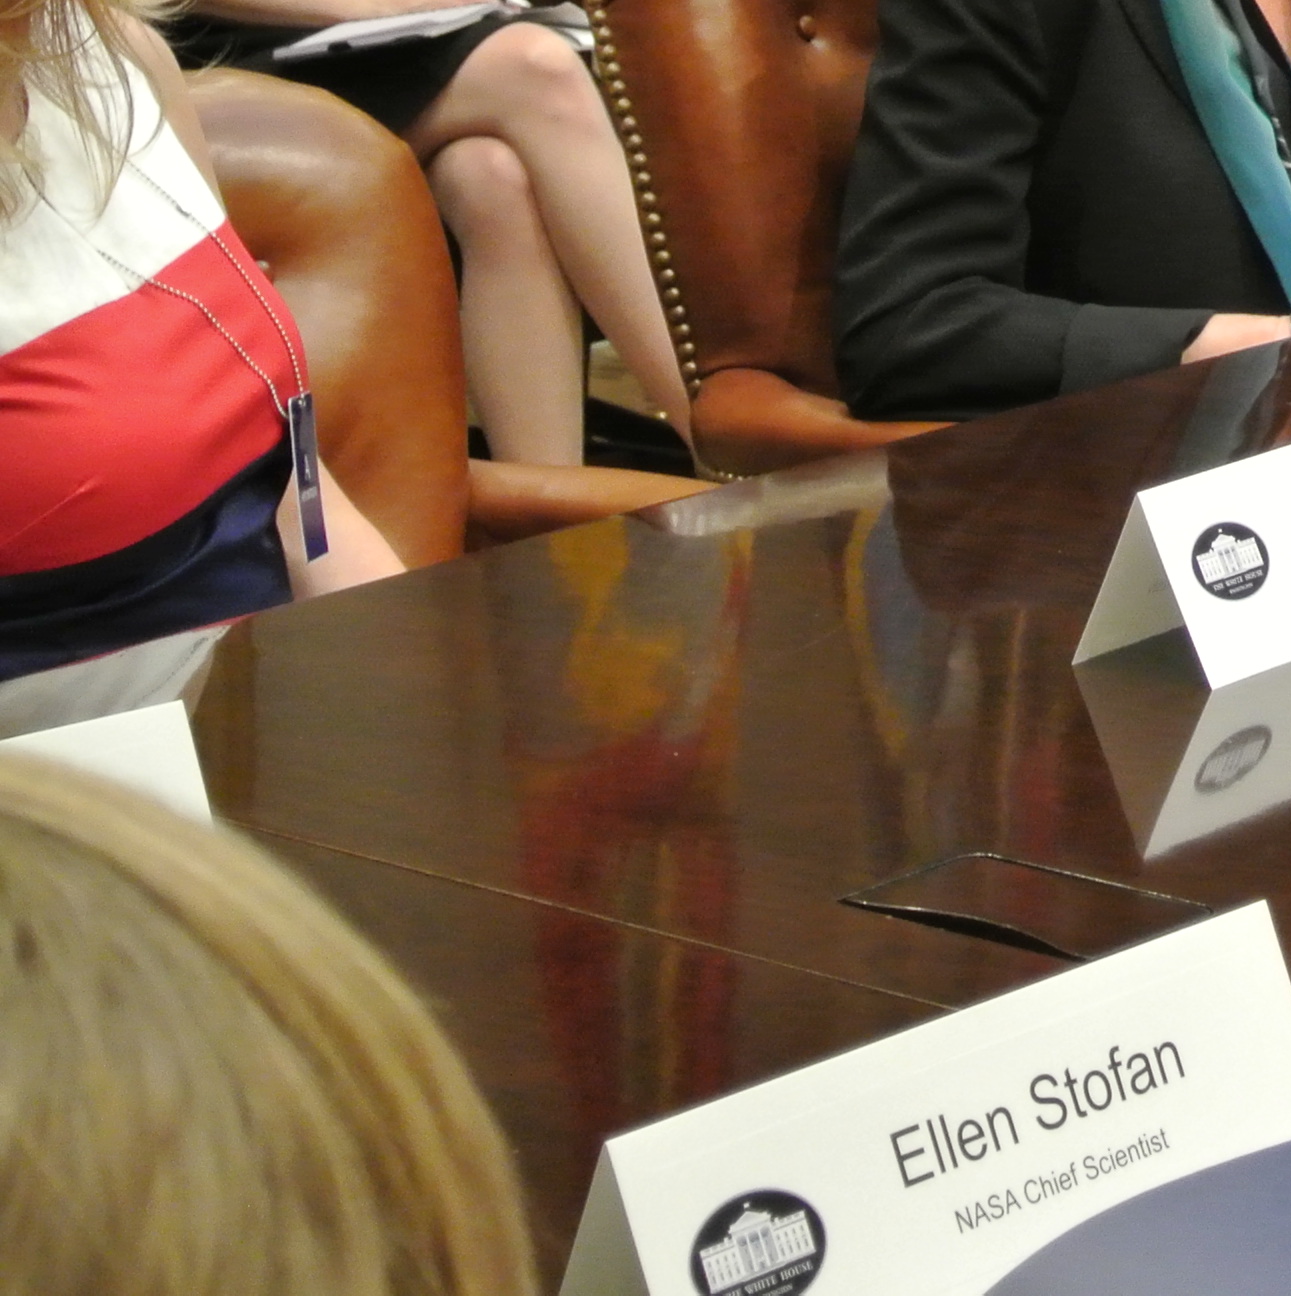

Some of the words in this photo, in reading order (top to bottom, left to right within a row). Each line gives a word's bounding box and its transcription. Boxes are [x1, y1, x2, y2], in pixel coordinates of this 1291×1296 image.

[890, 1105, 1020, 1188] Ellen
[1029, 1039, 1186, 1132] Stofan
[954, 1189, 1022, 1234] NASA
[1023, 1160, 1080, 1205] Chief
[1080, 1127, 1170, 1181] Scientist
[744, 1274, 778, 1295] WHITE
[779, 1260, 814, 1281] HOUSE
